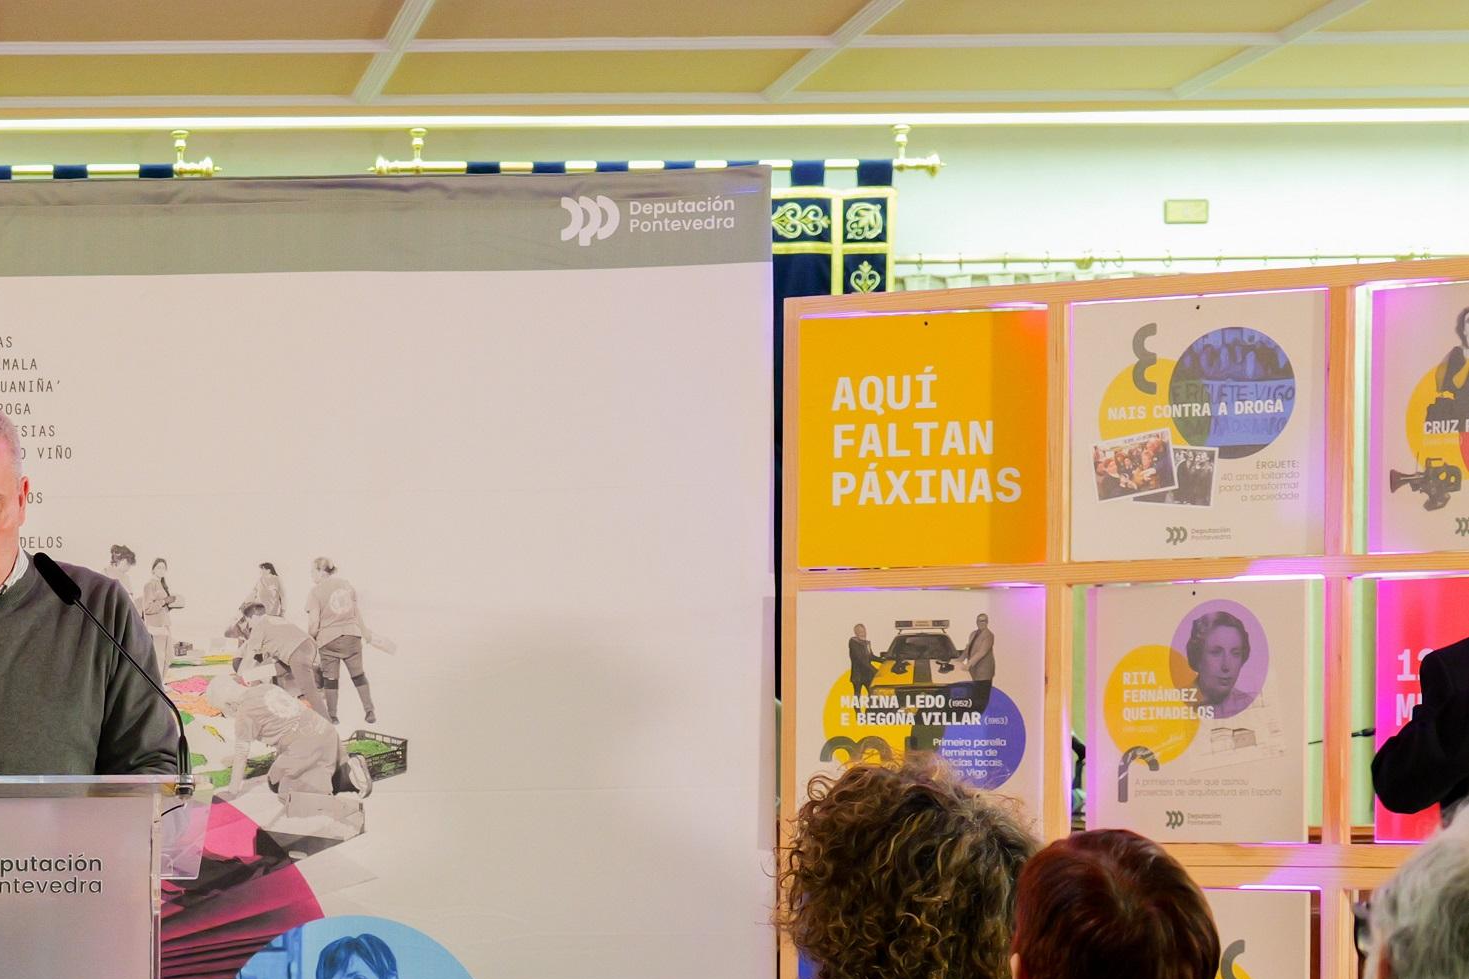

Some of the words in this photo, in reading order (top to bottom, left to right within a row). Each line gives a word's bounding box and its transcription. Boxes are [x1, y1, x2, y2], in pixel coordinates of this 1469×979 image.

[630, 195, 735, 218] Deputación
[630, 215, 735, 233] Pontevedra
[832, 366, 938, 415] AQUÍ
[1108, 407, 1146, 420] NAIS
[1153, 403, 1211, 418] CONTRA
[1218, 404, 1227, 415] A
[1235, 399, 1284, 415] DROGA
[1424, 420, 1460, 434] CRUZ
[833, 420, 994, 458] FALTAN
[37, 445, 72, 459] VIÑO
[832, 462, 1022, 506] PÁXINAS
[20, 536, 63, 549] DELOS
[1123, 671, 1156, 685] RITA
[840, 695, 899, 709] MARINA
[906, 695, 945, 708] LEDO
[1123, 686, 1198, 703] FERNÁNDEZ
[841, 714, 850, 726] E
[857, 709, 915, 726] BEGOÑA
[922, 712, 981, 726] VILLAR
[1124, 706, 1214, 721] QUEIMADELOS
